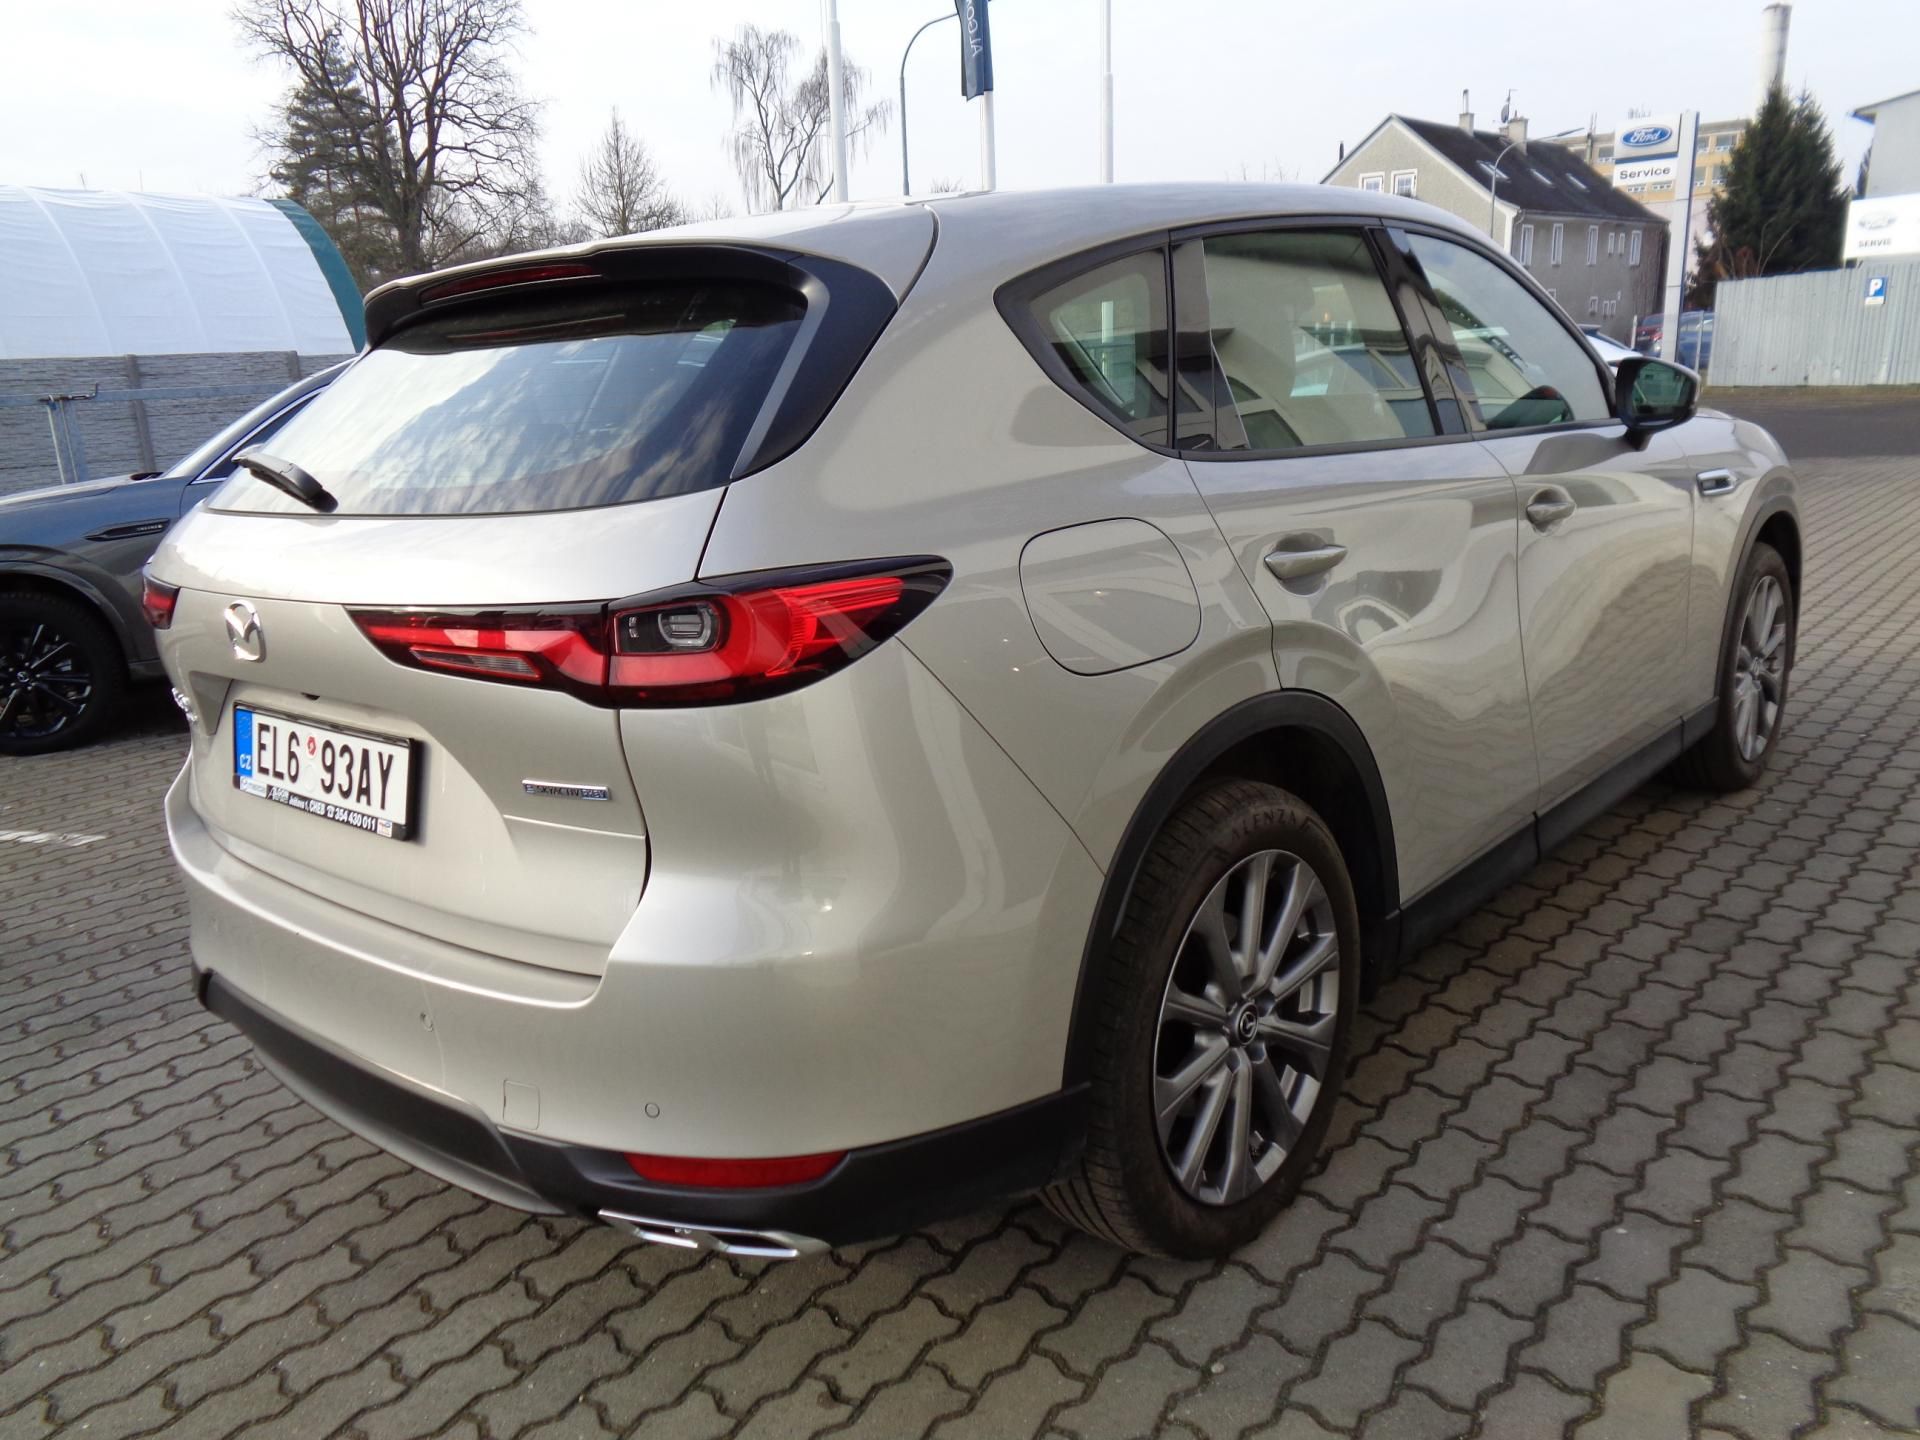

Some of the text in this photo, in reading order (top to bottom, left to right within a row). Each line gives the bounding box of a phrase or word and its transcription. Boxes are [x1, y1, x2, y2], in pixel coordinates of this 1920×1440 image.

[1630, 128, 1662, 143] Ford
[1620, 167, 1671, 179] Service
[1869, 278, 1883, 296] P
[239, 753, 252, 770] CZ
[257, 722, 394, 810] EL6 93AY
